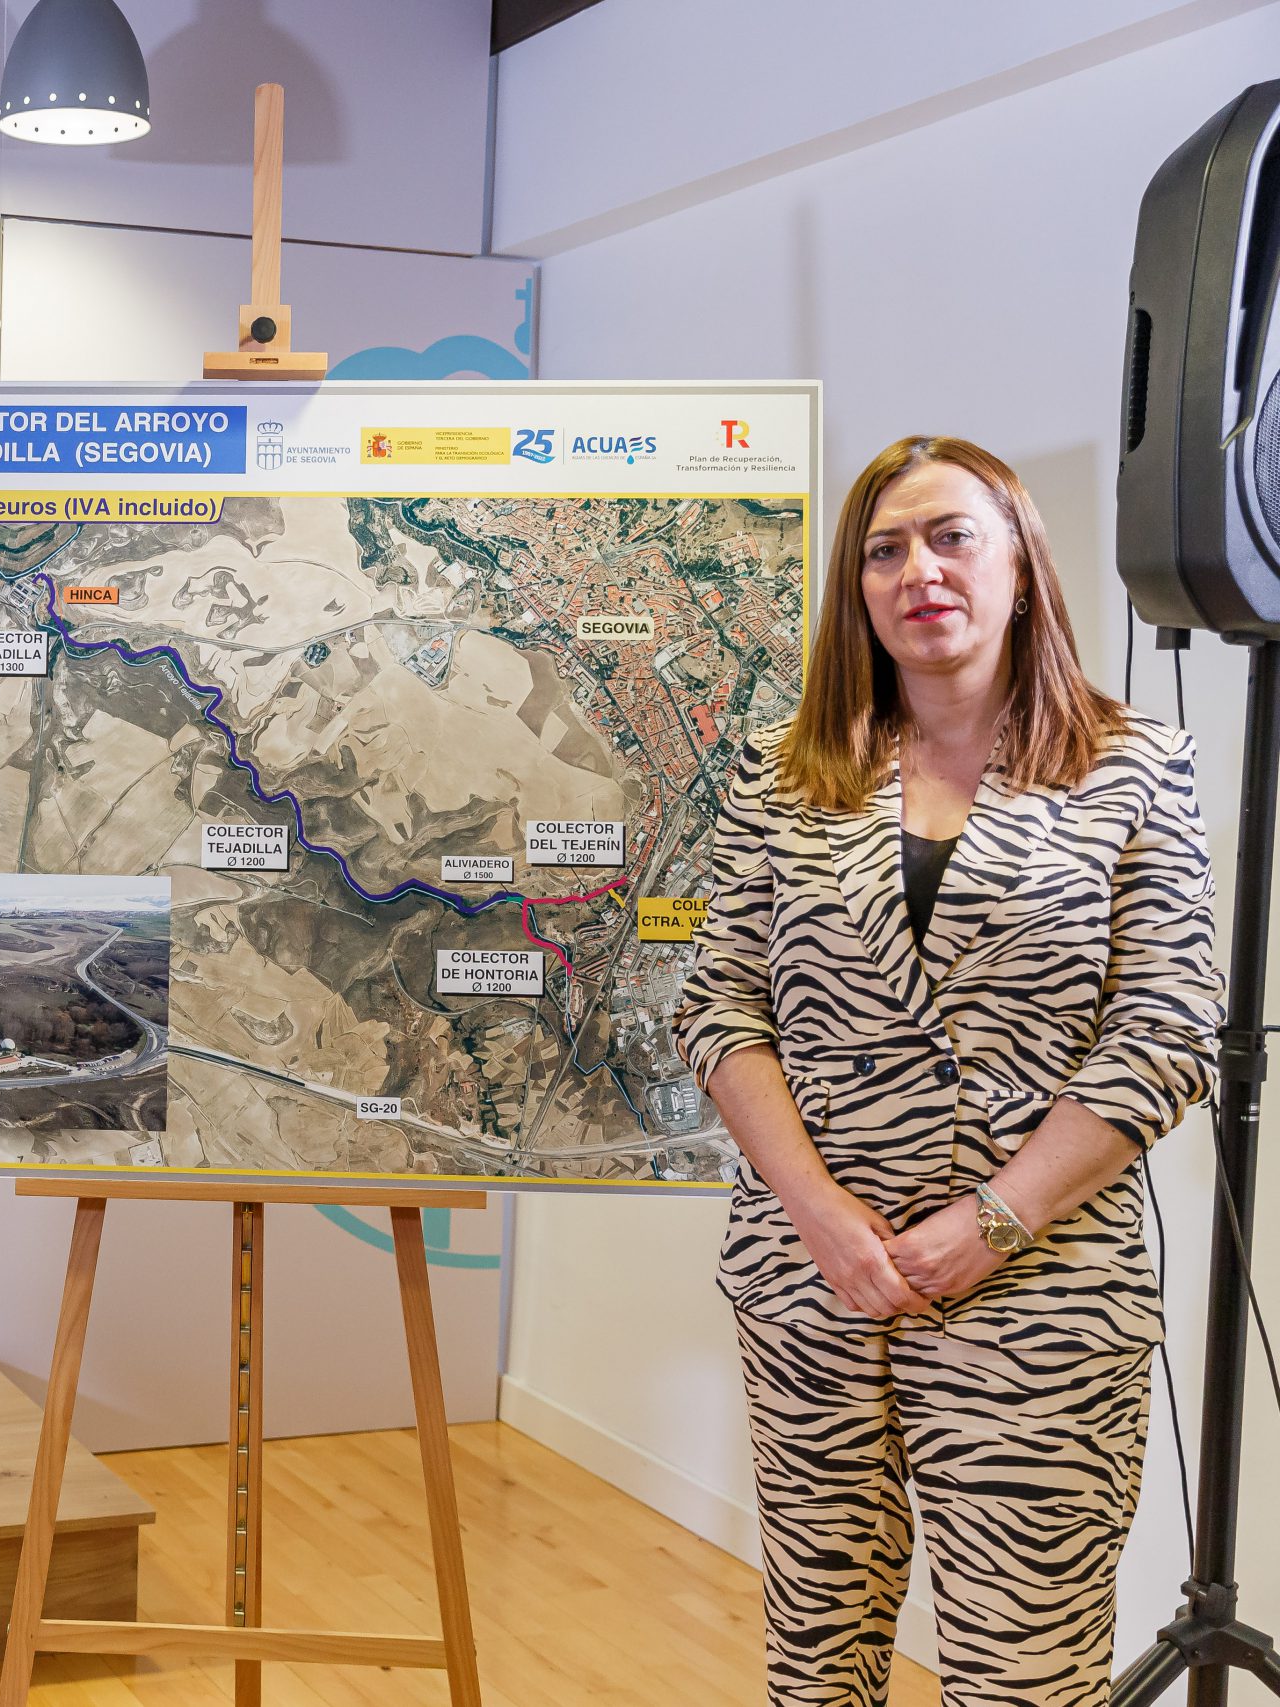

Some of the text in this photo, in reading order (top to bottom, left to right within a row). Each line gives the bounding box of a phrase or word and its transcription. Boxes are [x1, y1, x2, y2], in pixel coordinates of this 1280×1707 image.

[56, 412, 107, 432] DEL
[114, 412, 228, 433] ARROYO
[512, 429, 555, 456] 25
[75, 441, 212, 468] (SEGOVIA)
[286, 455, 337, 463] DE SEGOVIA
[689, 455, 783, 464] Plan de Recuperación,
[676, 464, 741, 472] Transformación
[751, 464, 796, 472] Resiliencia
[64, 498, 110, 519] (IVA
[118, 498, 216, 520] incluido)
[70, 589, 113, 601] HINCA
[582, 622, 649, 634] SEGOVIA
[1, 662, 24, 672] 1300
[158, 664, 202, 710] Arroyo Tejadilla
[206, 826, 284, 838] COLECTOR
[536, 822, 614, 835] COLECTOR
[207, 842, 283, 855] TEJADILLA
[529, 837, 620, 851] DEL TEJERÍN
[240, 857, 265, 866] 1200
[569, 853, 595, 863] 1200
[444, 859, 510, 870] ALIVIADERO
[474, 871, 494, 879] 1500
[641, 915, 684, 927] CTRA.
[451, 951, 529, 964] COLECTOR
[441, 968, 539, 981] DE HONTORIA
[486, 983, 512, 993] 1200
[360, 1102, 398, 1114] SG-20
